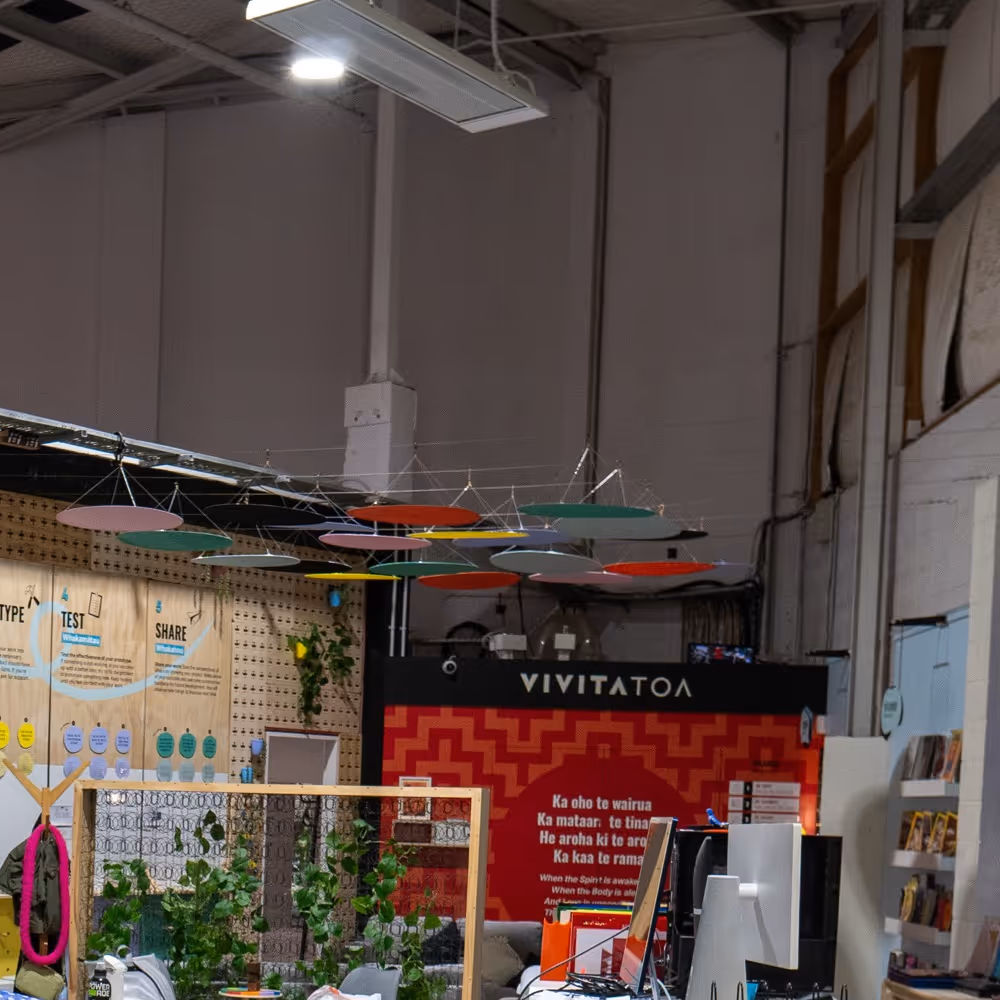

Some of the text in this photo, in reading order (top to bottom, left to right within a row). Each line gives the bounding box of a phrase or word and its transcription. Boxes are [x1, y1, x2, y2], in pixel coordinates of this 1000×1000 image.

[61, 611, 85, 630] TEST
[155, 622, 187, 642] SHARE
[552, 794, 652, 811] Ka oho te wairua
[537, 812, 553, 826] Ka
[556, 814, 602, 828] mataar
[609, 815, 622, 829] te
[540, 830, 556, 844] He
[559, 832, 593, 846] aroha
[596, 833, 608, 847] ki
[611, 834, 624, 847] te
[553, 849, 569, 864] Ka
[572, 850, 594, 864] kaa
[598, 851, 610, 865] te
[540, 873, 563, 883] When
[565, 874, 579, 884] the
[603, 876, 611, 885] is
[552, 886, 575, 895] When
[577, 887, 590, 896] the
[591, 887, 613, 898] Body
[614, 888, 622, 897] is
[544, 897, 561, 905] And
